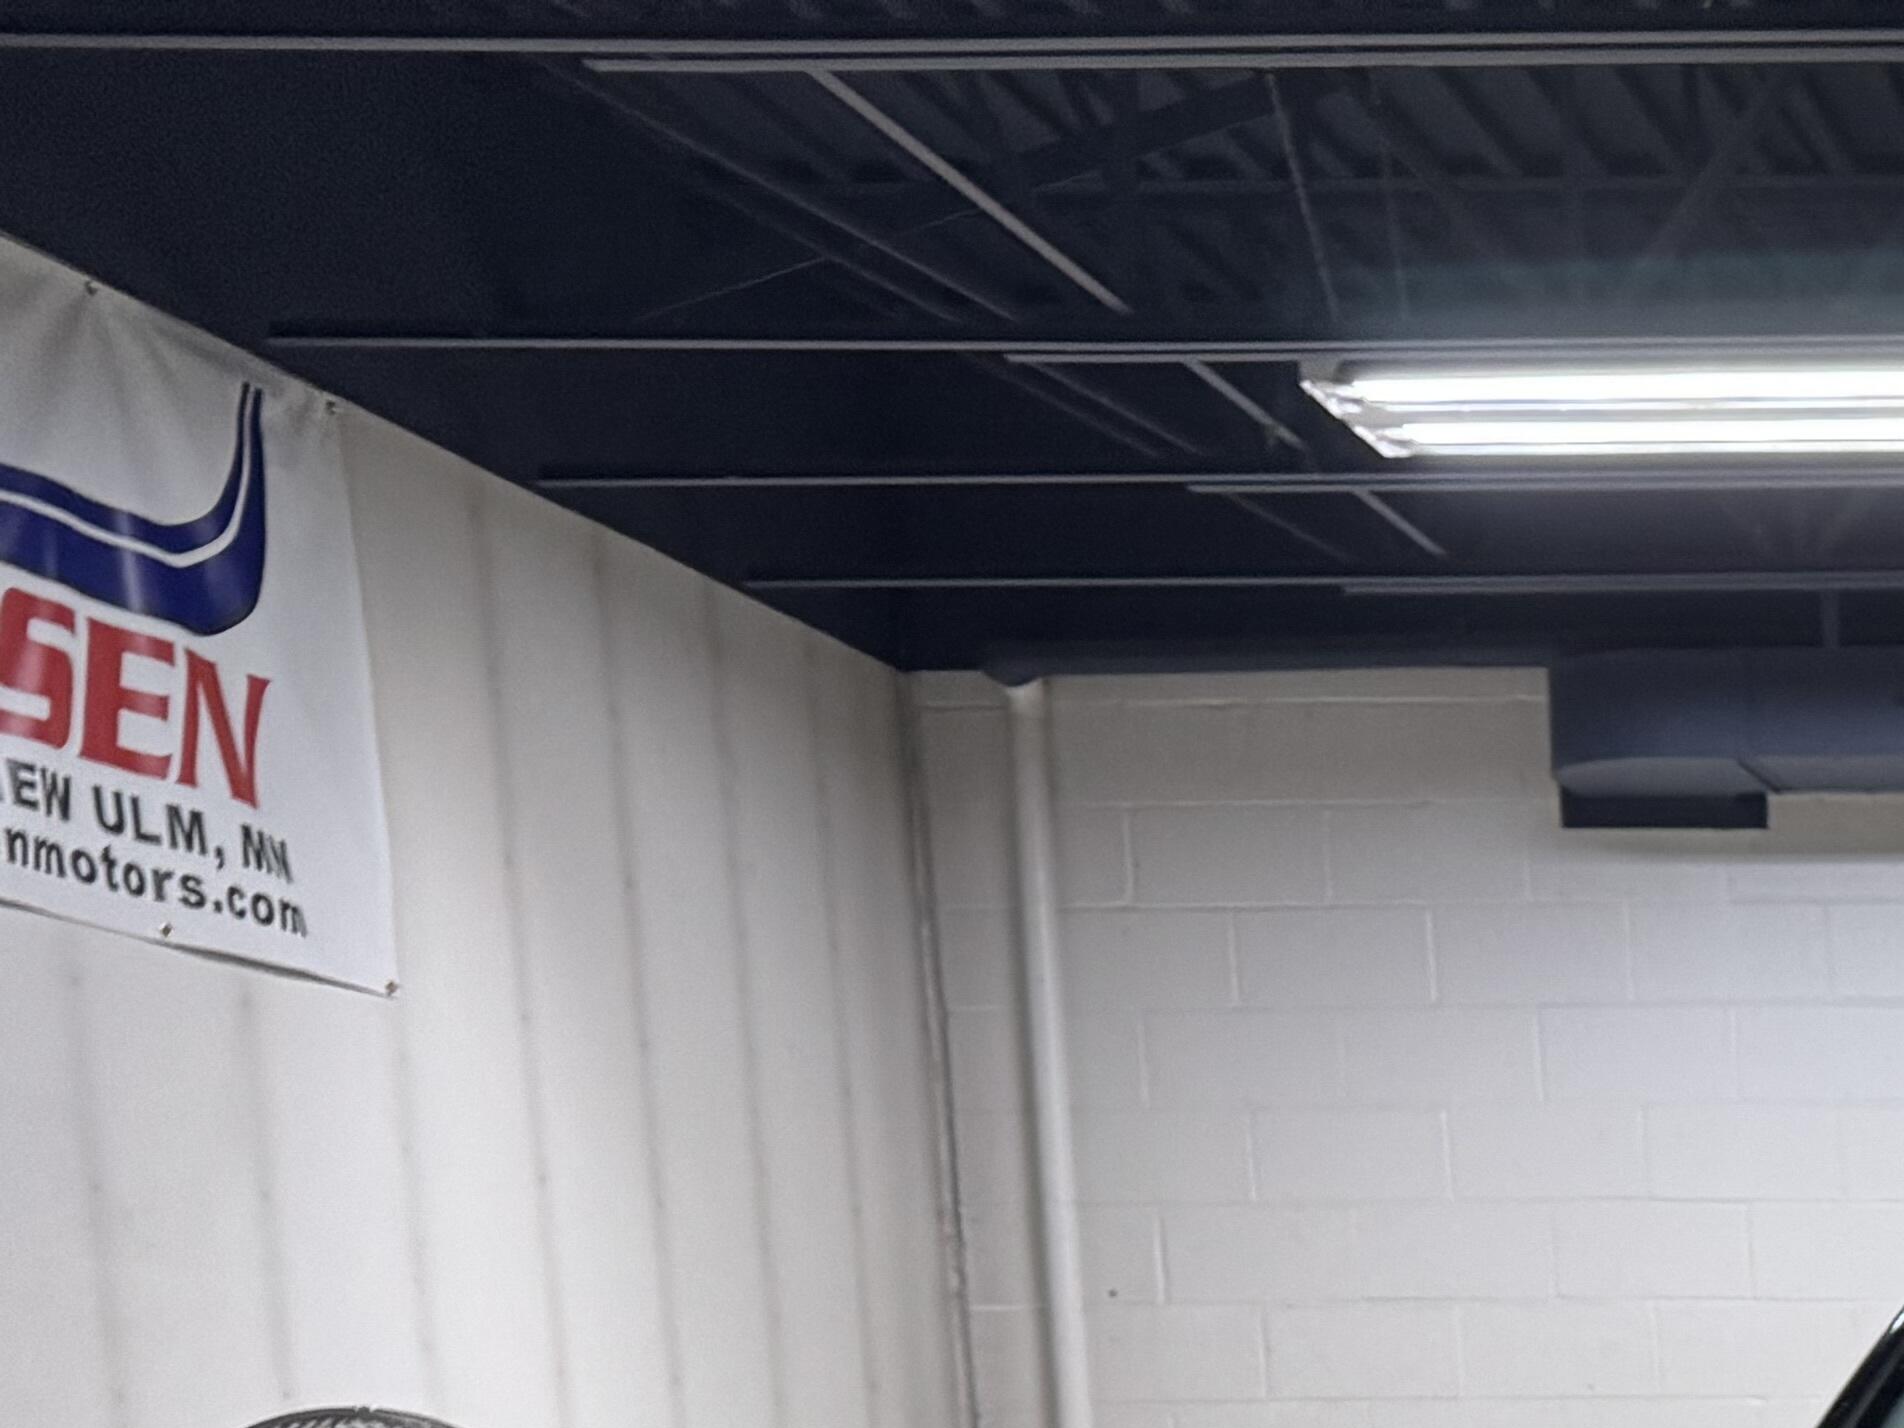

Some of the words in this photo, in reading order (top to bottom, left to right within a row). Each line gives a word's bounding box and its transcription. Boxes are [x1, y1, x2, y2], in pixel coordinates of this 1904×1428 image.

[0, 758, 71, 821] EW
[92, 785, 225, 870] ULM,
[241, 823, 294, 884] MN
